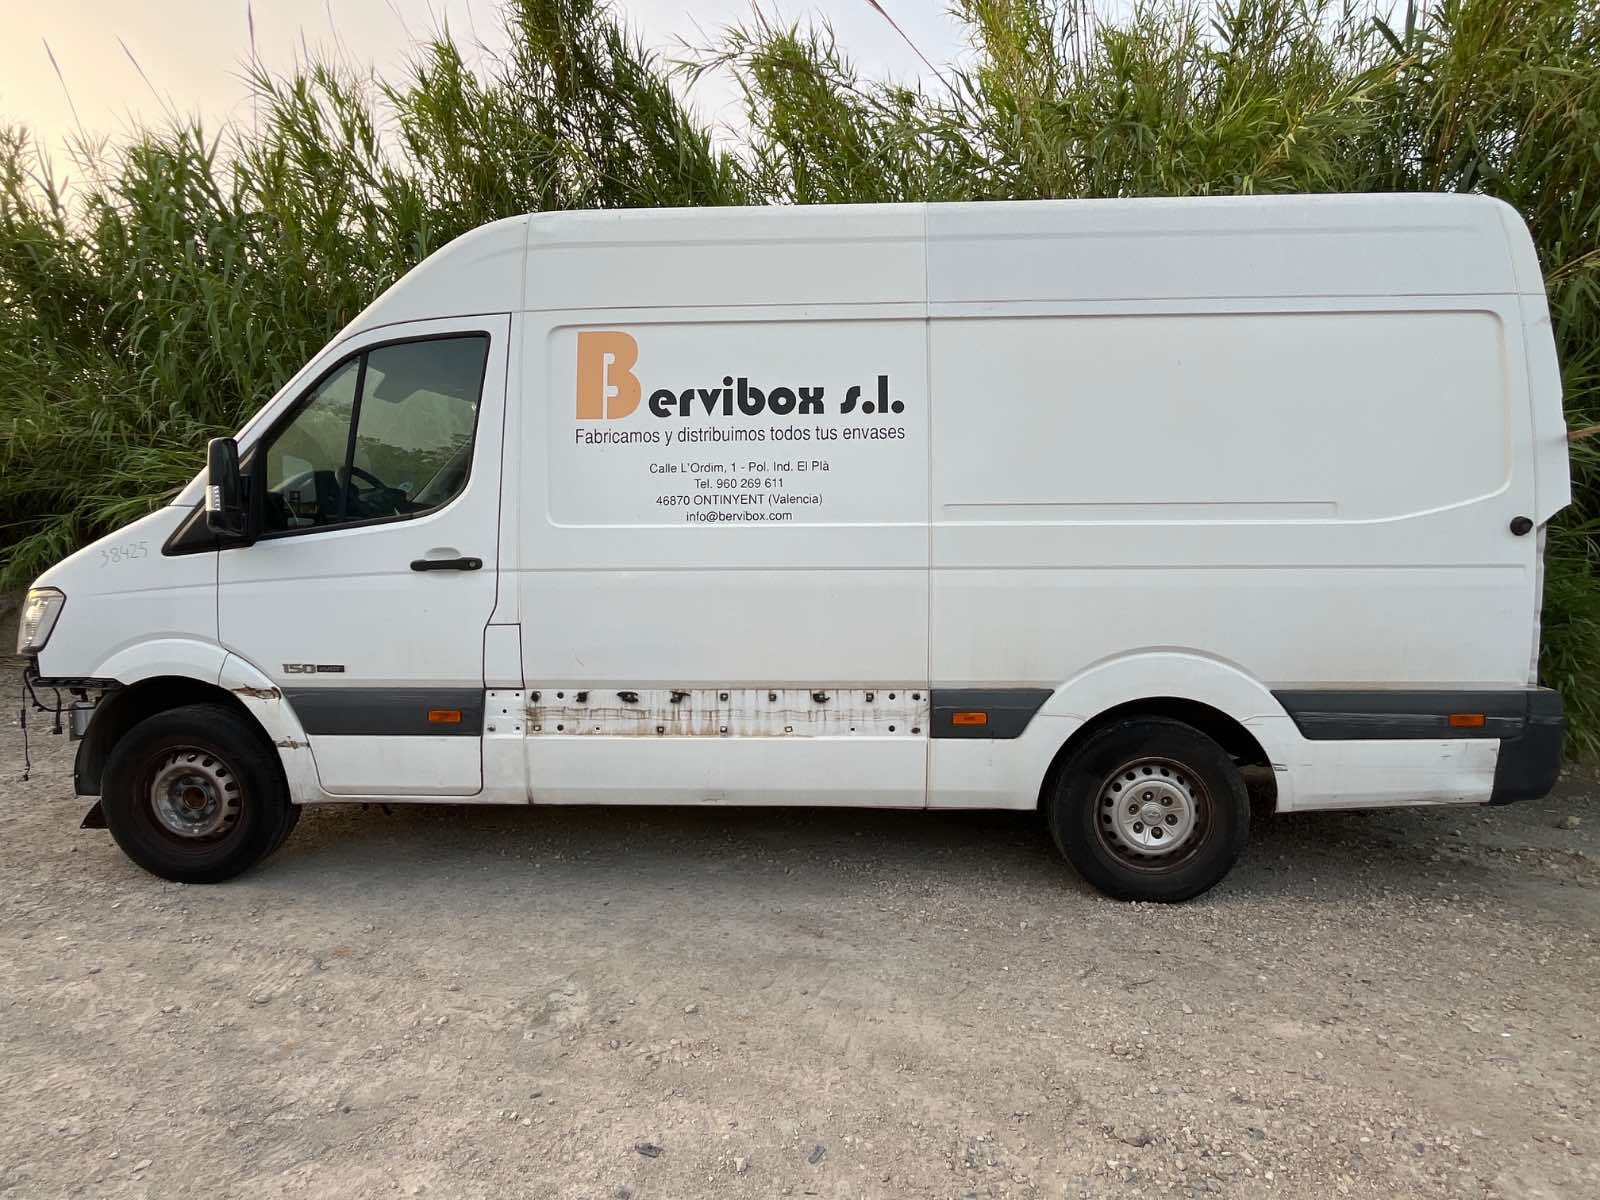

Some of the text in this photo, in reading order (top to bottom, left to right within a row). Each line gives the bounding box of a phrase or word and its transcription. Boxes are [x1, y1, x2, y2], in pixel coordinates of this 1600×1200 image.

[575, 330, 905, 420] Bervibox s.l.
[575, 425, 905, 446] Fabricamos y distribuimos todos tus envases
[649, 462, 677, 474] Calle
[681, 462, 727, 474] L'Ordim,
[730, 462, 736, 473] 1
[748, 462, 770, 472] Pol.
[773, 462, 793, 472] Ind.
[798, 462, 808, 471] El
[695, 478, 783, 489] Tel. 960 269 611
[656, 493, 823, 505] 46870 ONTINYENT (Valencia)
[686, 511, 793, 522] info@bervibox.com
